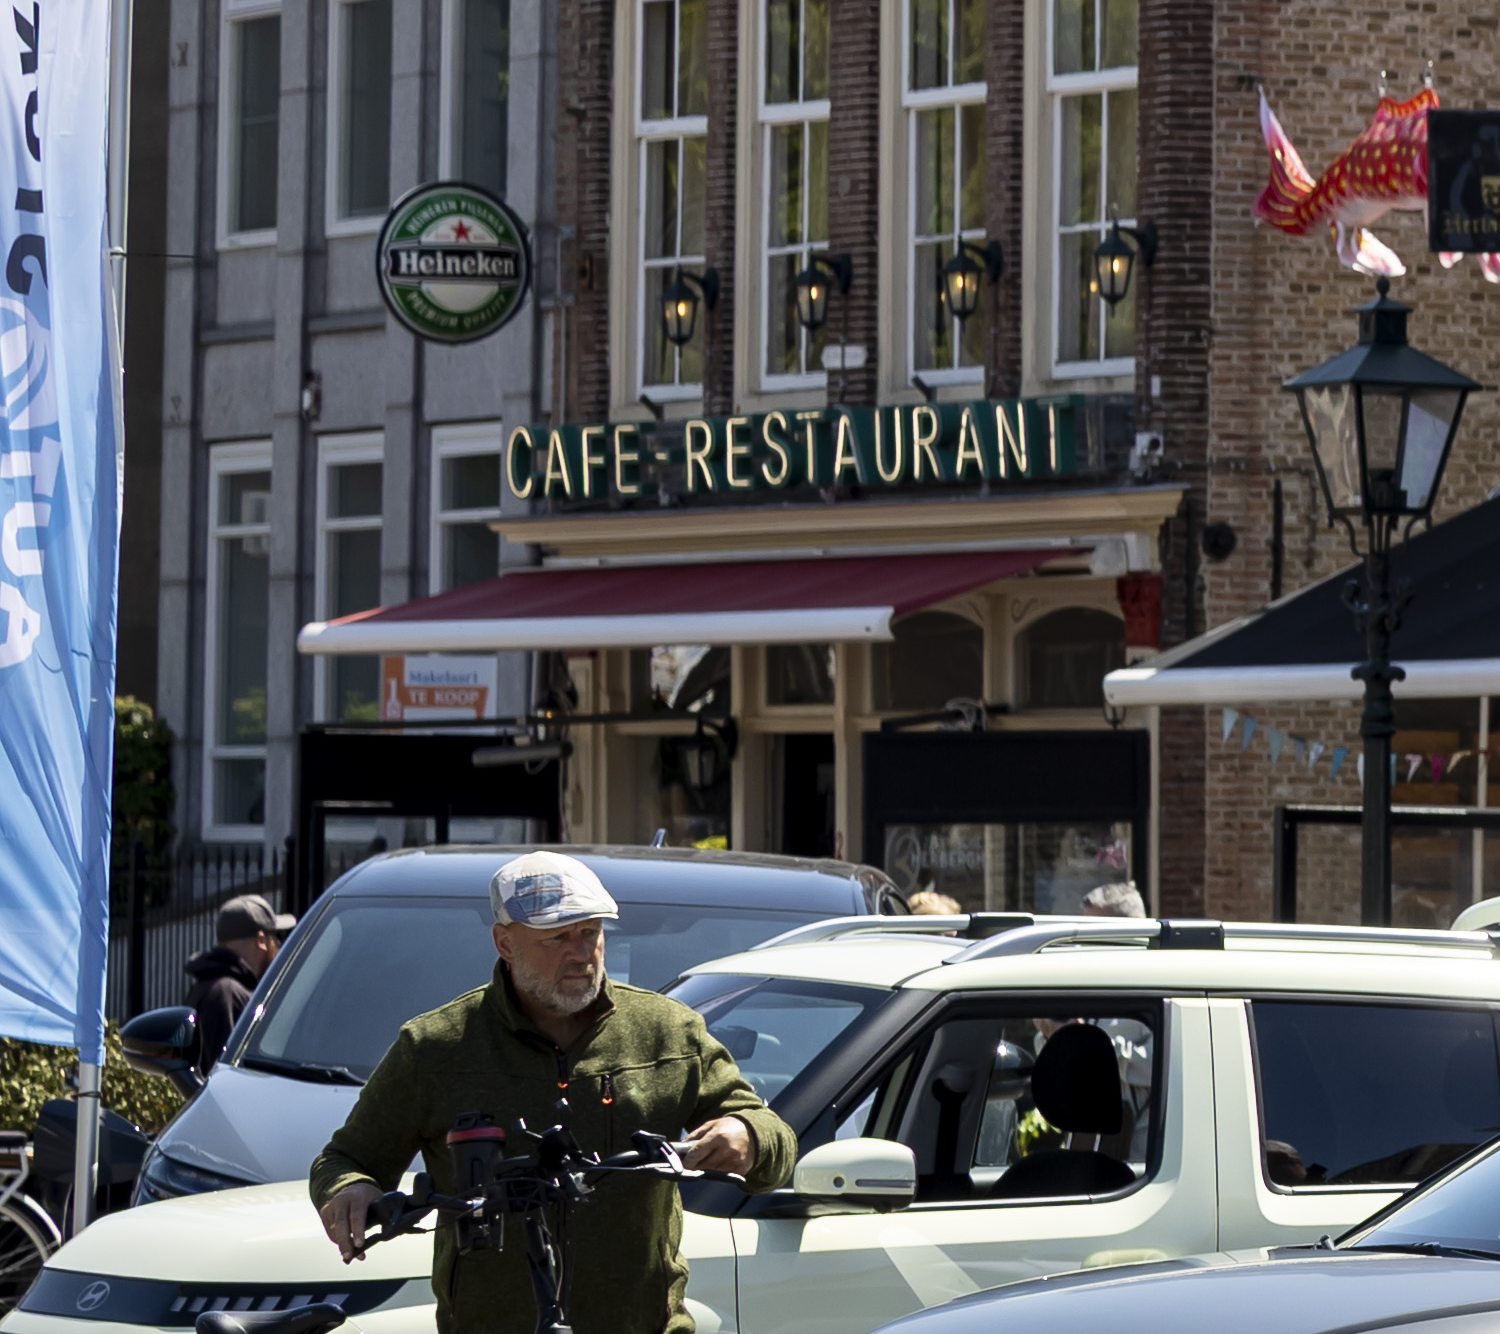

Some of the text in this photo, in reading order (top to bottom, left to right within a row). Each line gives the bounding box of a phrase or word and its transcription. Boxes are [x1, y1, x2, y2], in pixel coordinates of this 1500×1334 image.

[399, 250, 515, 276] Heineken
[409, 689, 479, 705] TE KOOP
